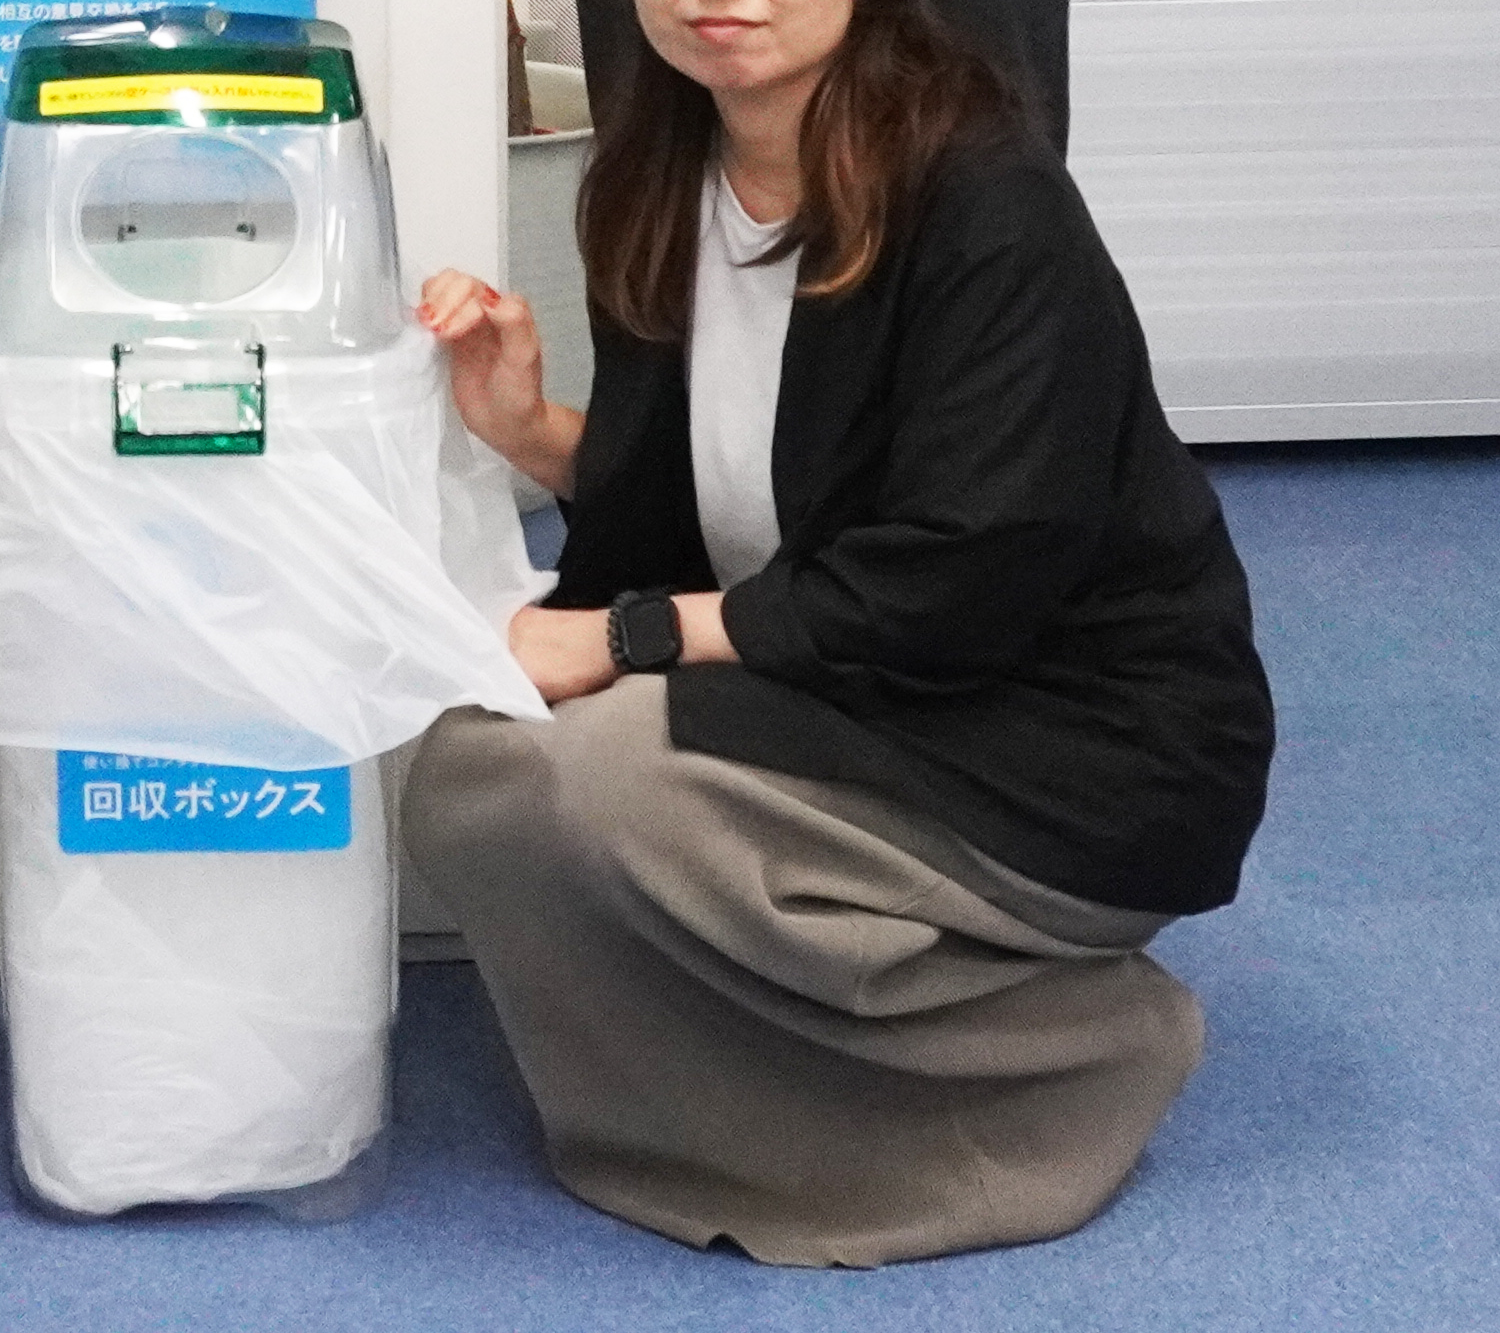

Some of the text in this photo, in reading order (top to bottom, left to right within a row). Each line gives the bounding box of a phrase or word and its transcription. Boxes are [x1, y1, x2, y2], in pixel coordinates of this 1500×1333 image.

[83, 778, 326, 821] 回収ボックス
